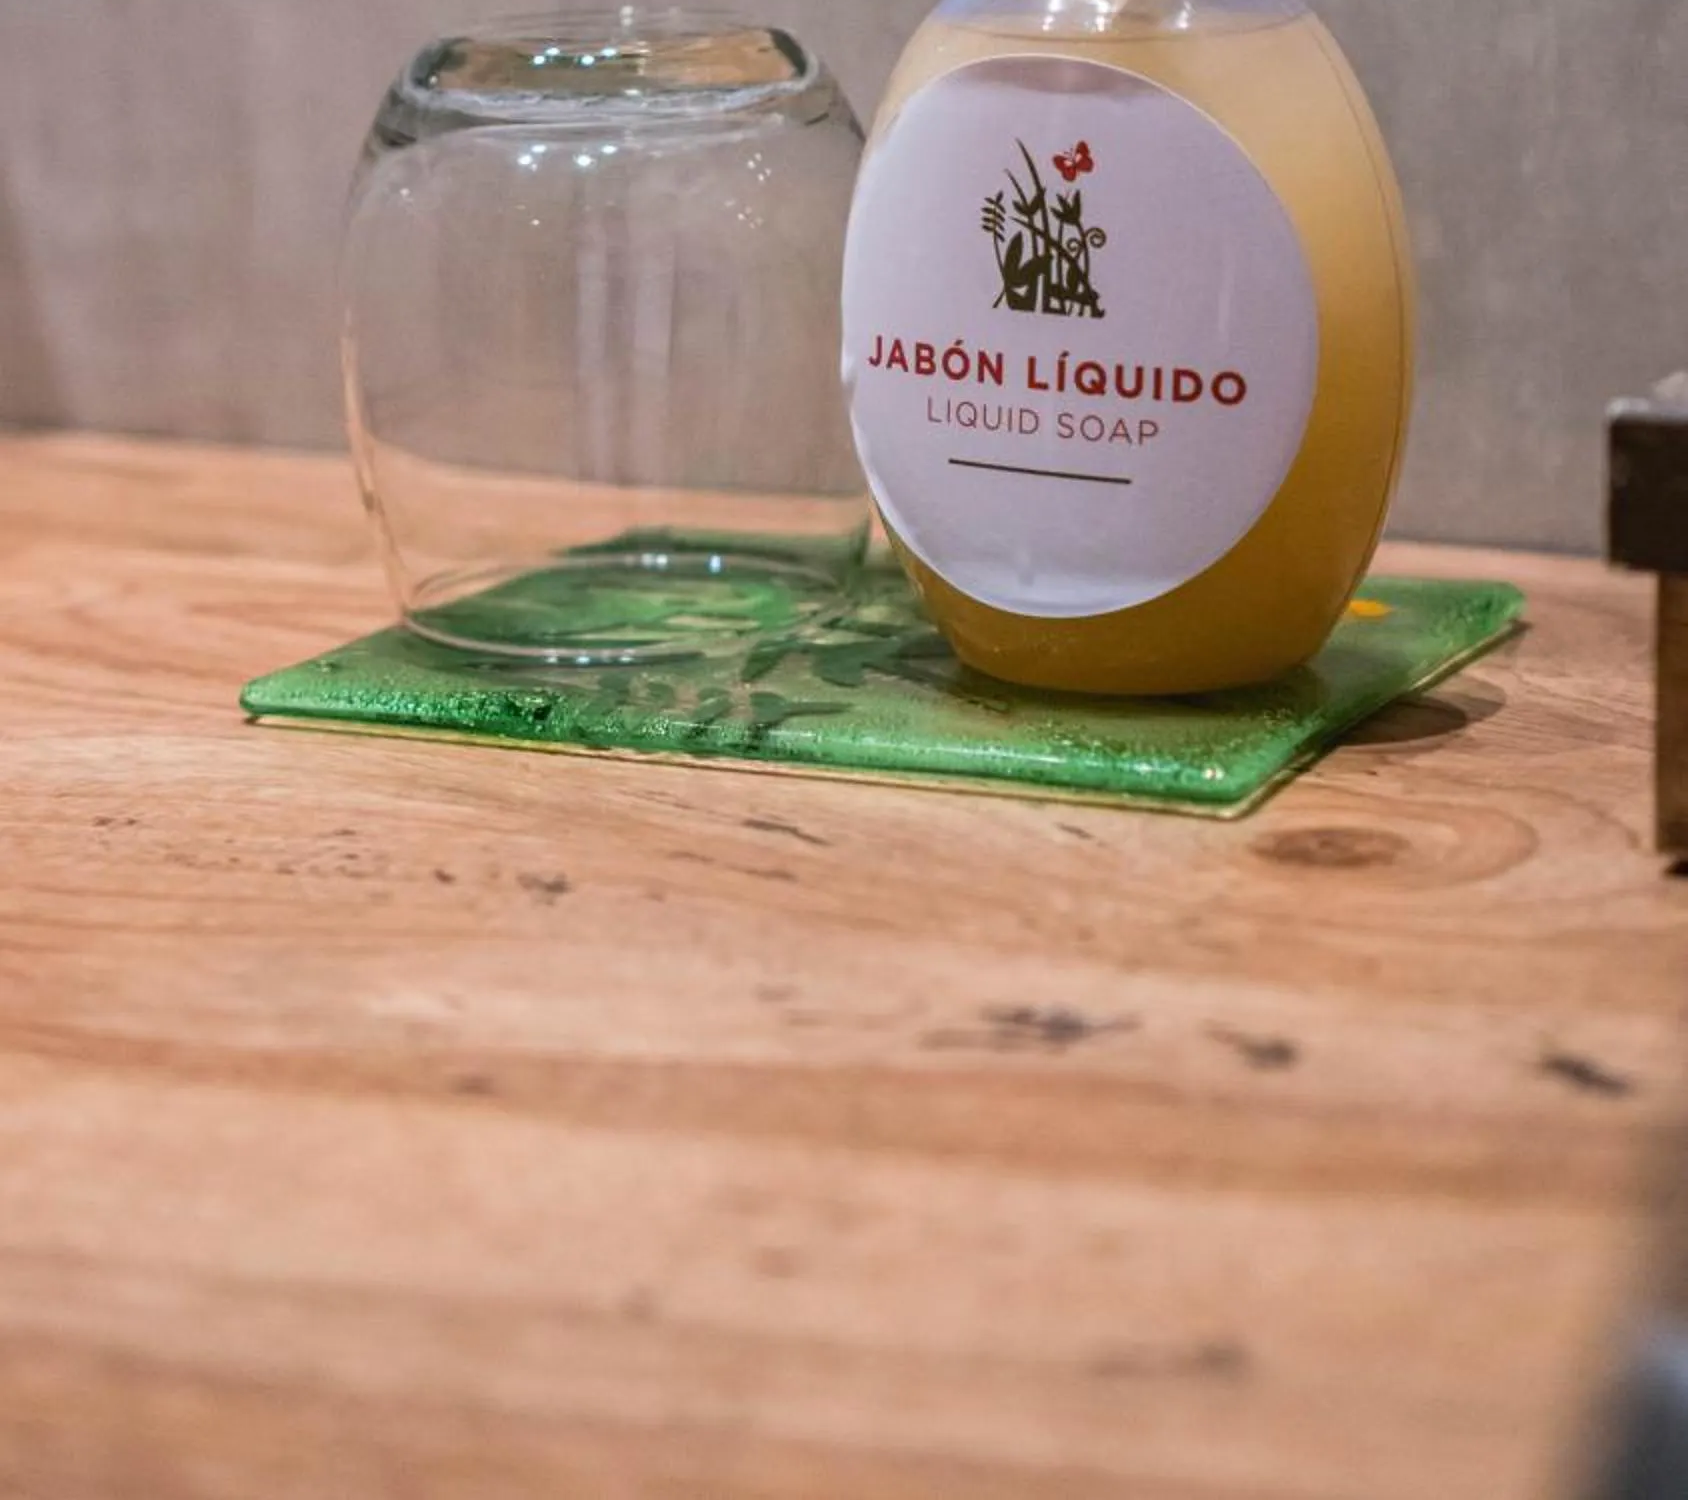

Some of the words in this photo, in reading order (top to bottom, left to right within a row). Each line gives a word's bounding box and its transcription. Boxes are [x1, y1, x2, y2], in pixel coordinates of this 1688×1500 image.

[868, 336, 1003, 385] JABÓN
[1027, 351, 1247, 405] LÍQUIDO
[927, 397, 1040, 435] LIQUID
[1056, 412, 1159, 446] SOAP
